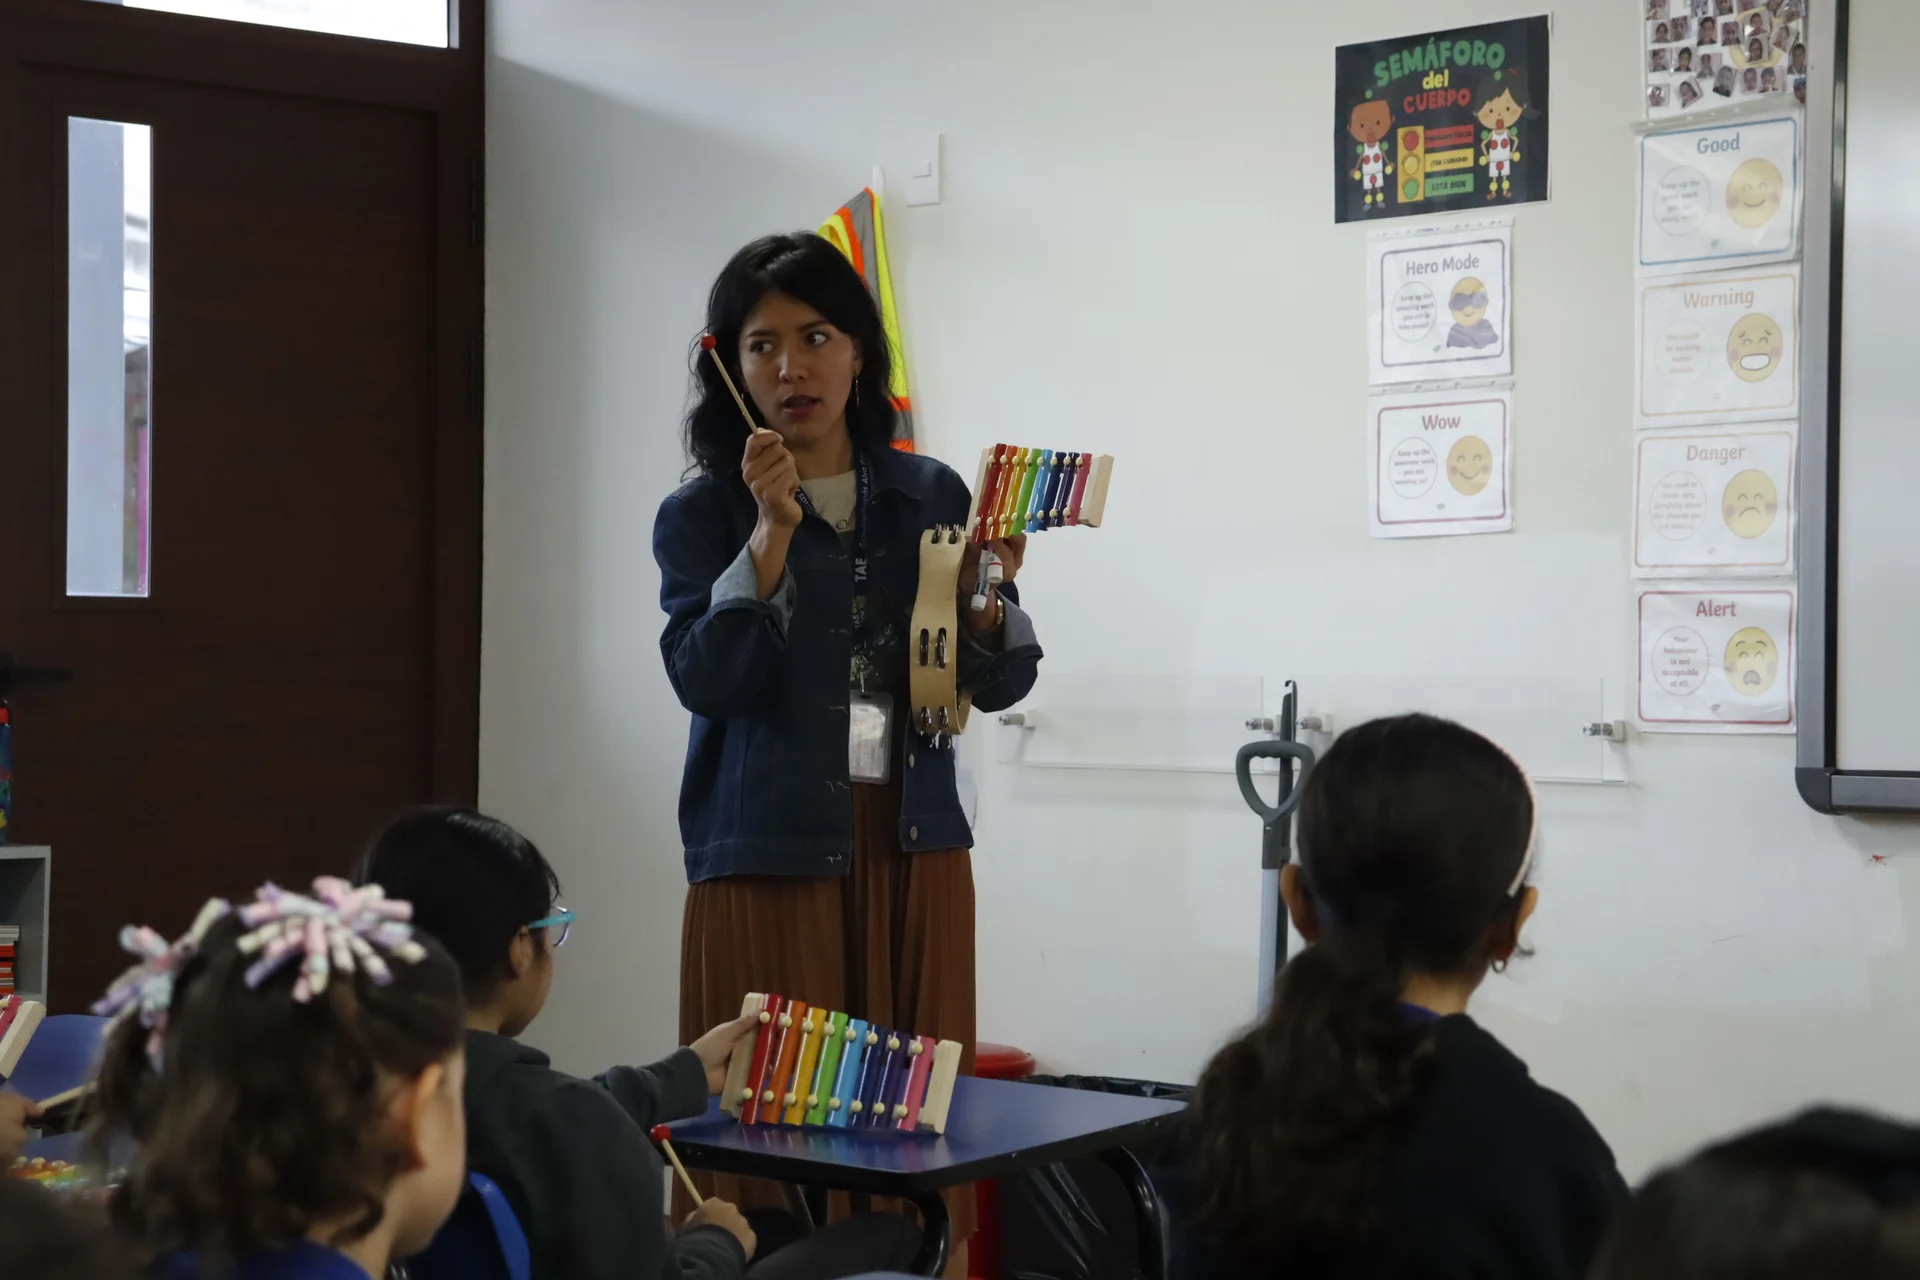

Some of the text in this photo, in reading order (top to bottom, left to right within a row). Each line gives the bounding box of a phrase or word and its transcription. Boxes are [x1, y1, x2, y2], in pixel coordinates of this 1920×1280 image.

[1374, 36, 1506, 87] SEMÁFORO
[1422, 69, 1450, 90] del
[1404, 88, 1471, 114] CUERPO
[1696, 132, 1740, 154] Good
[1406, 253, 1479, 276] Hero Mode
[1684, 288, 1754, 308] Warning
[1422, 414, 1461, 431] Wow
[1687, 445, 1746, 465] Danger
[854, 558, 867, 583] TAE
[1696, 599, 1737, 617] Alert
